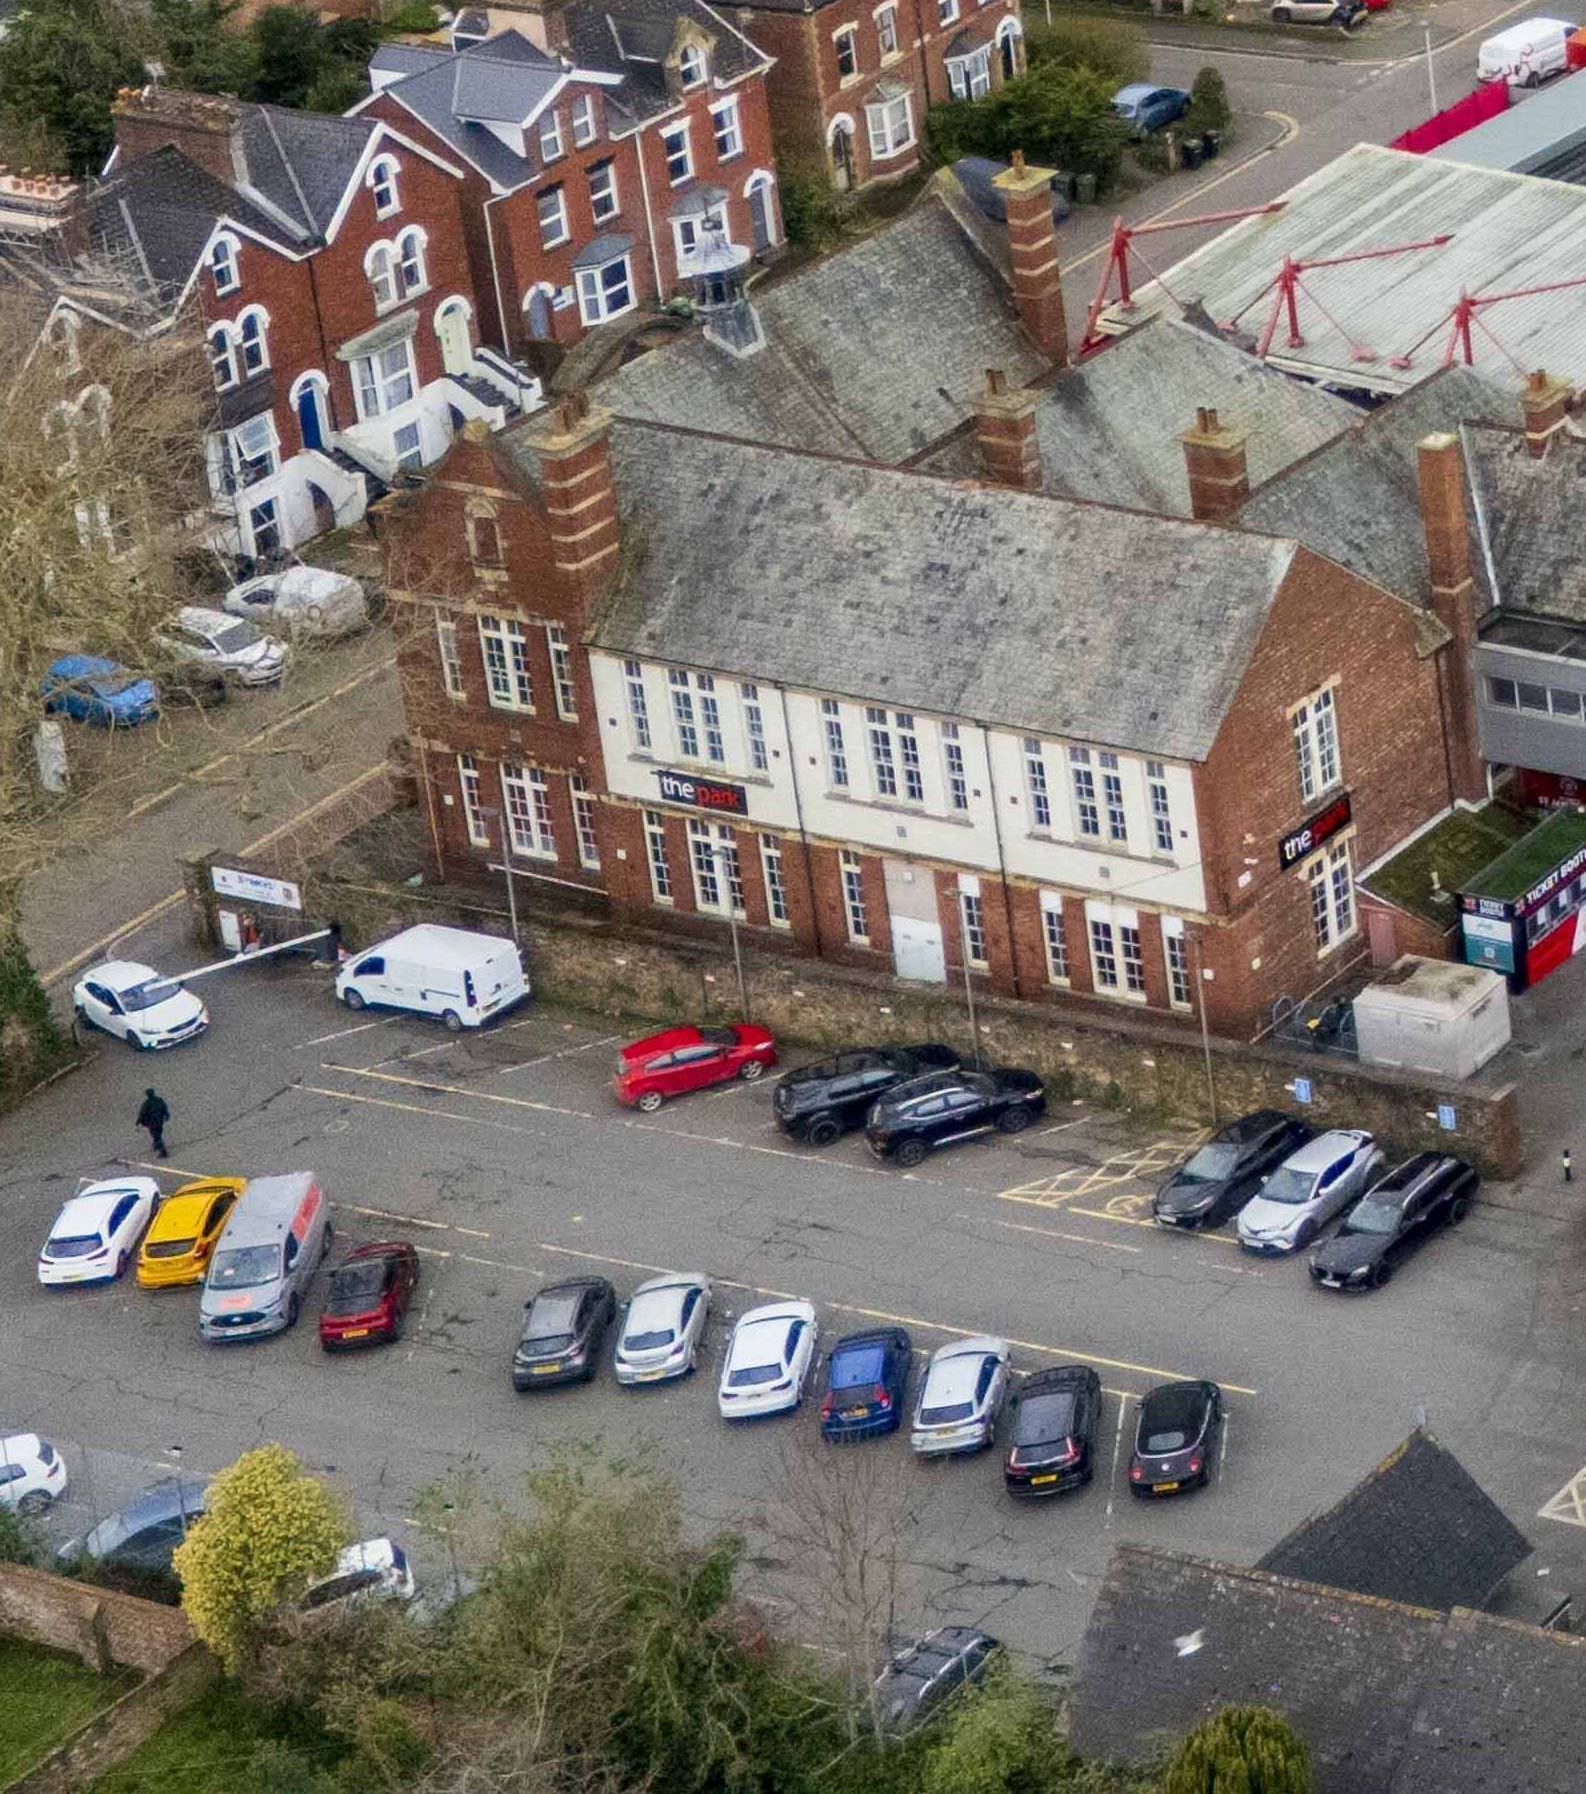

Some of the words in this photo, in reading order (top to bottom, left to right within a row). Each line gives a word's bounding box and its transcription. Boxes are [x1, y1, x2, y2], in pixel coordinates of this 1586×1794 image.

[662, 776, 694, 798] the
[697, 786, 740, 806] park
[1284, 830, 1312, 860] the
[1526, 869, 1559, 904] TICKET
